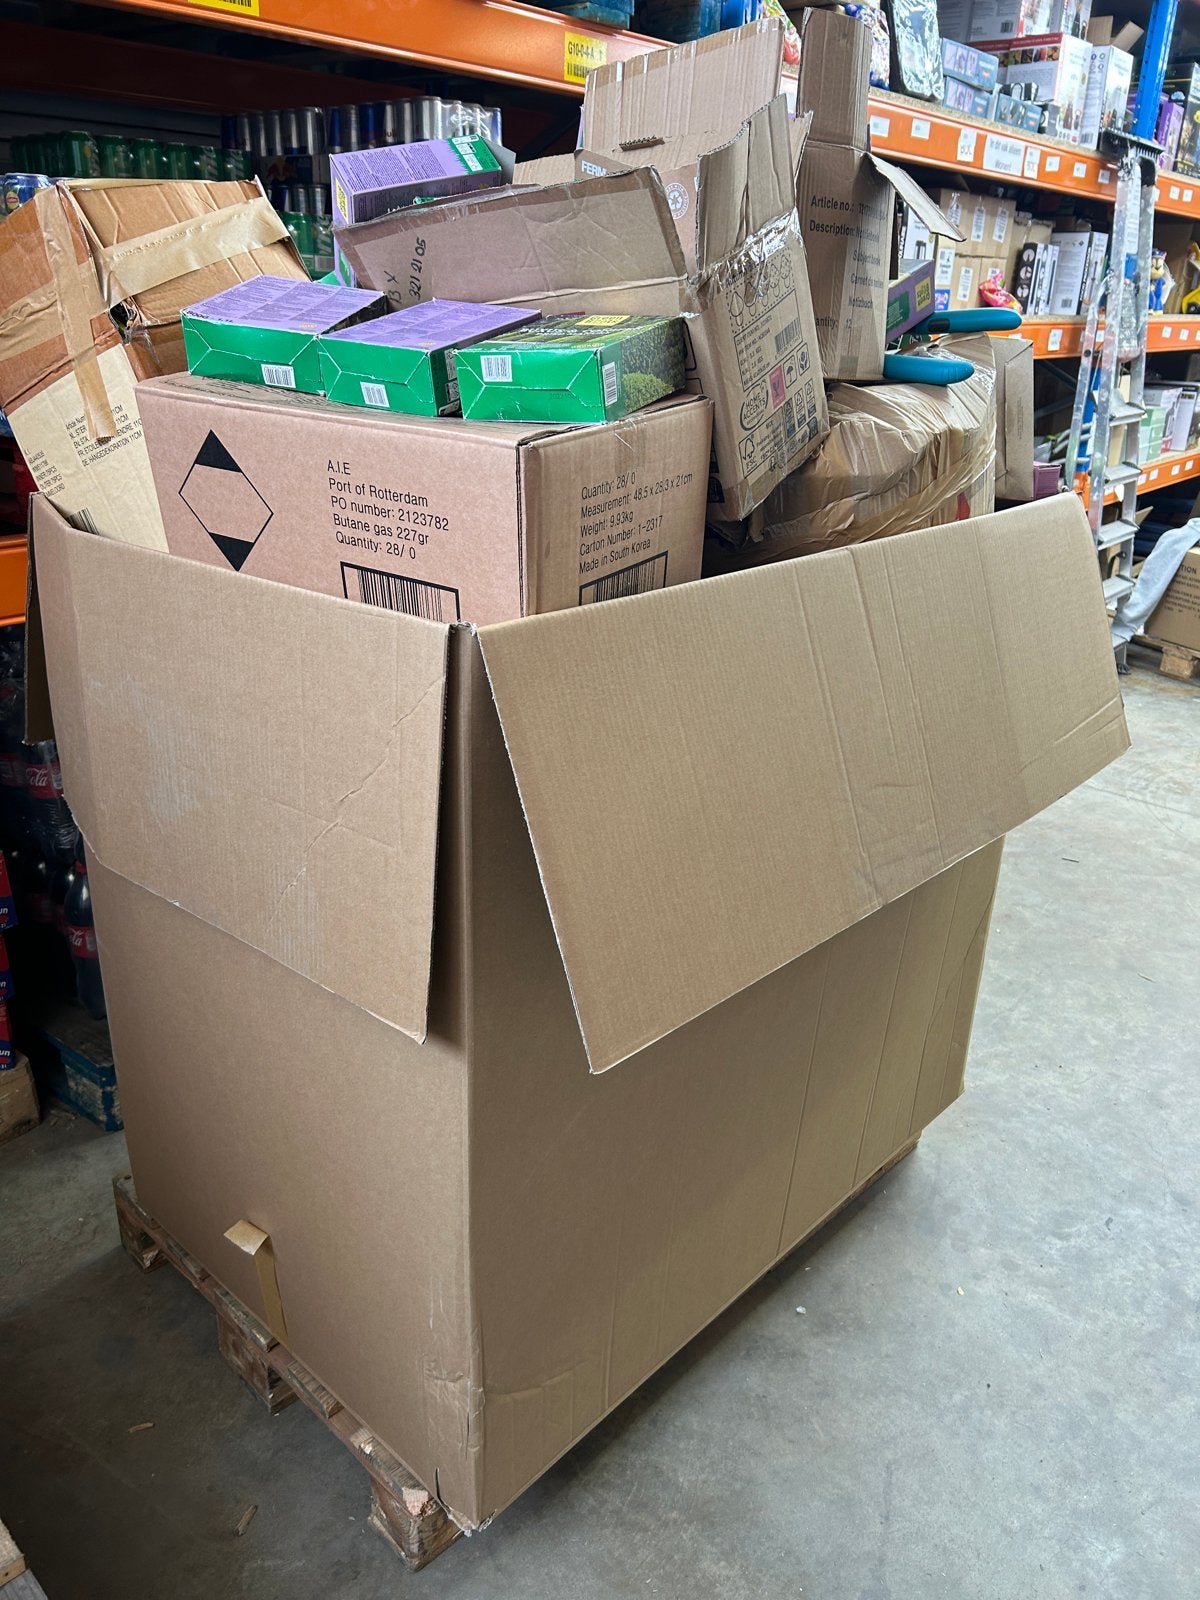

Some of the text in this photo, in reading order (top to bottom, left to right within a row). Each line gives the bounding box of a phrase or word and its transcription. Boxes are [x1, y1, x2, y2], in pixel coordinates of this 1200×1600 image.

[810, 195, 839, 210] Article
[809, 219, 855, 237] Description:
[408, 236, 427, 301] 321 21 05
[815, 315, 838, 330] antity:
[743, 398, 766, 421] ACCENTS
[745, 393, 761, 409] HOME
[327, 459, 351, 476] A.I.E
[745, 456, 757, 470] FSC
[328, 477, 429, 508] Port of Rotterdam
[580, 493, 632, 519] Measurement:
[633, 486, 648, 502] 48.5
[675, 473, 693, 488] 21cm
[581, 481, 614, 500] Quantity:
[330, 495, 449, 531] PO number: 2123782
[333, 513, 429, 545] Butane gas 227gr
[580, 511, 634, 538] Weight: 9.93kg
[335, 531, 382, 553] Quantity:
[579, 539, 605, 556] Carton
[606, 528, 636, 547] Number:
[579, 538, 651, 575] Made in South Korea
[1181, 564, 1197, 575] TION
